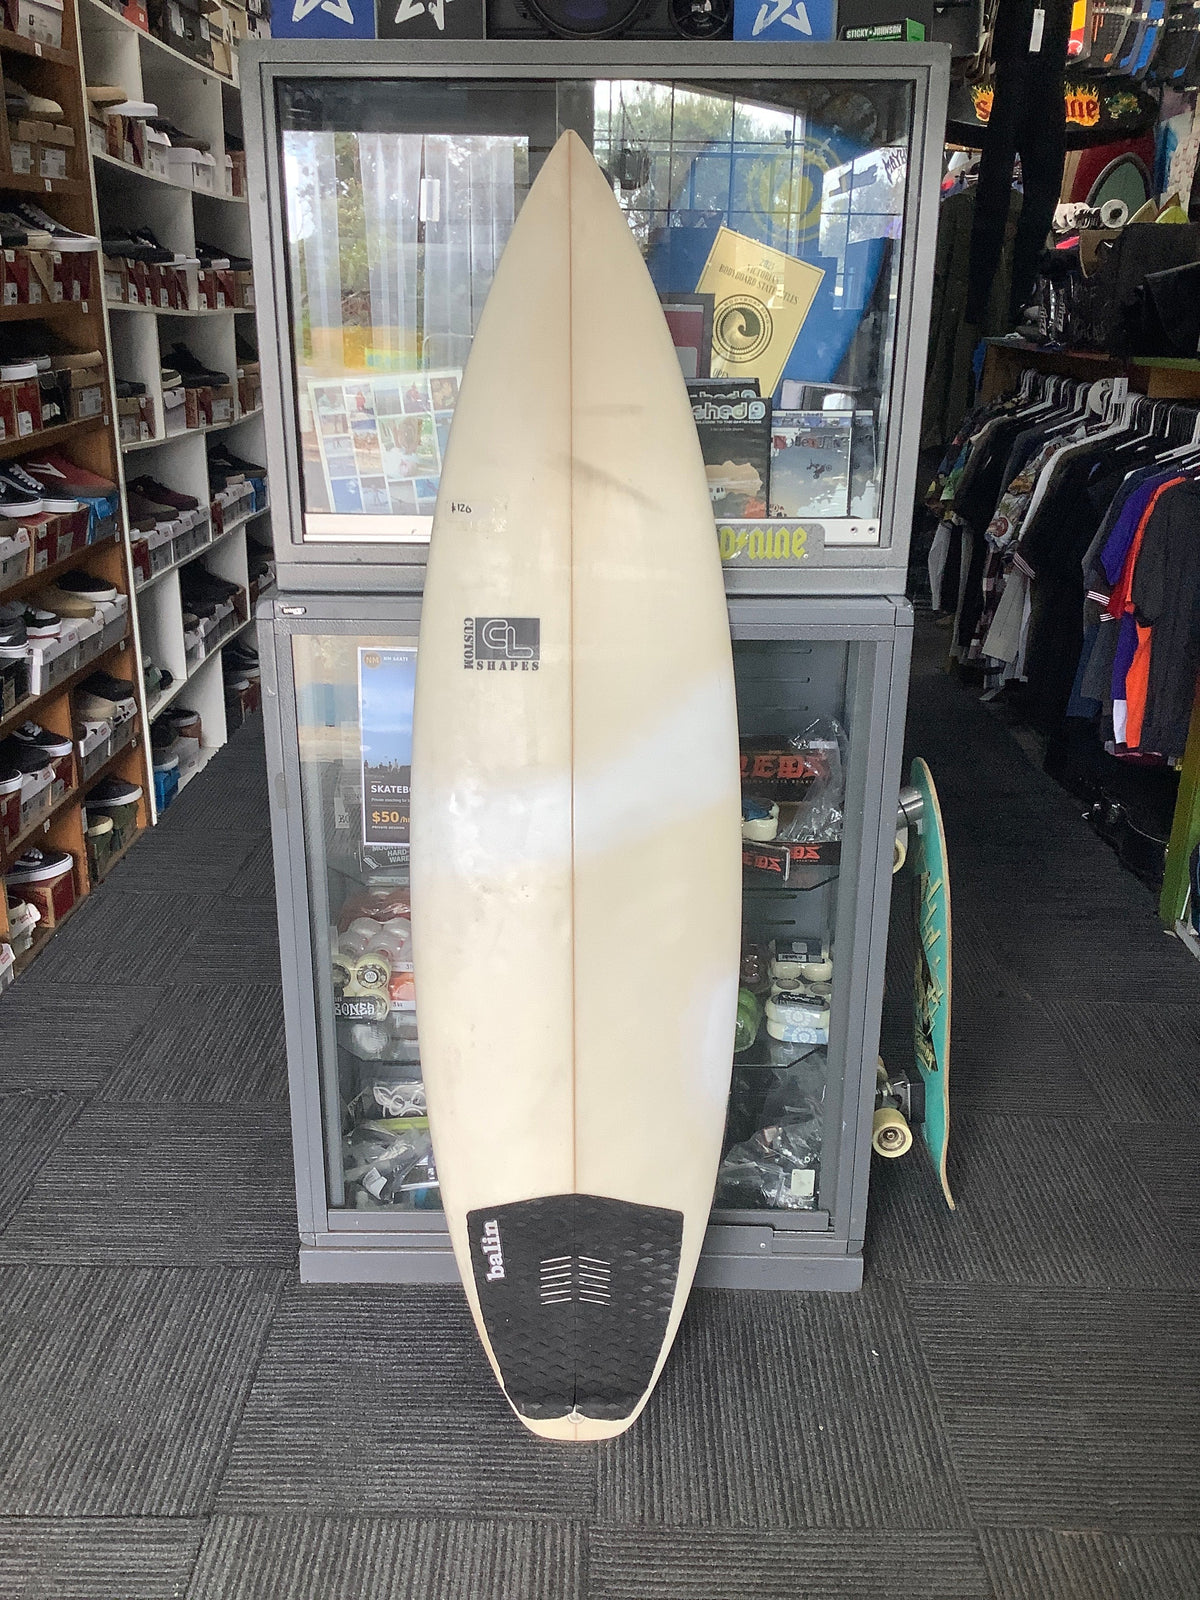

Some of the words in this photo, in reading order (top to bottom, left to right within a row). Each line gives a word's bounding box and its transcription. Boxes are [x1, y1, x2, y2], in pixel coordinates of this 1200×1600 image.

[846, 28, 868, 39] STICKY
[873, 24, 902, 36] JOHNSON
[464, 617, 474, 670] CUSTOM
[476, 661, 540, 671] SHAPES
[370, 785, 411, 794] SKATEB
[482, 1219, 505, 1282] balin
